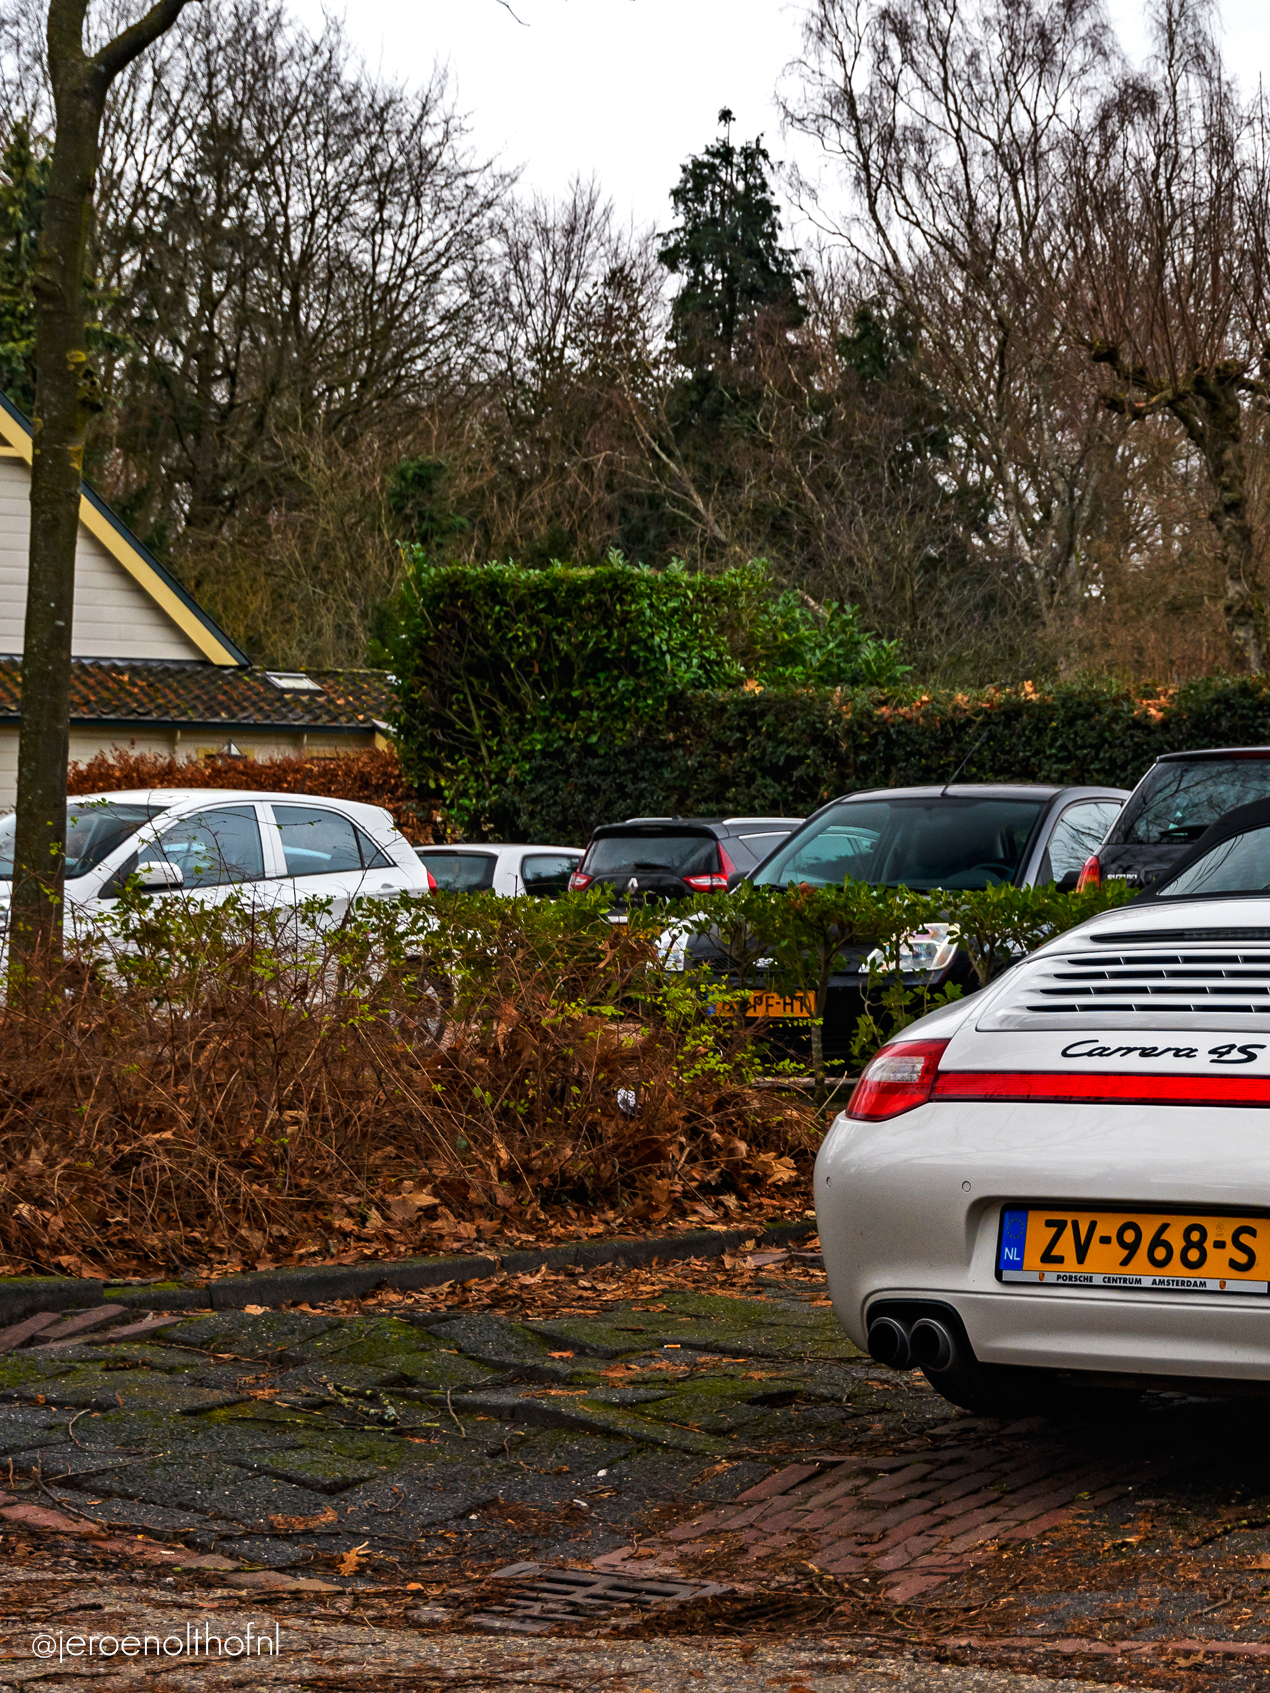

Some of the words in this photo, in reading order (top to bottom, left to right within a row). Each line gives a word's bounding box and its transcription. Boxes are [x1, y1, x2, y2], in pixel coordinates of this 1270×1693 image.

[1107, 873, 1138, 881] SUZUKI
[722, 995, 807, 1014] -PF-HT
[1061, 1039, 1199, 1058] Carrera
[1208, 1043, 1267, 1064] 4S
[1003, 1246, 1020, 1261] NL
[1040, 1218, 1258, 1273] ZV-968-S
[1056, 1274, 1094, 1284] PORSCHE
[1102, 1276, 1142, 1286] CENTRUM
[1151, 1278, 1207, 1289] AMSTERDAM
